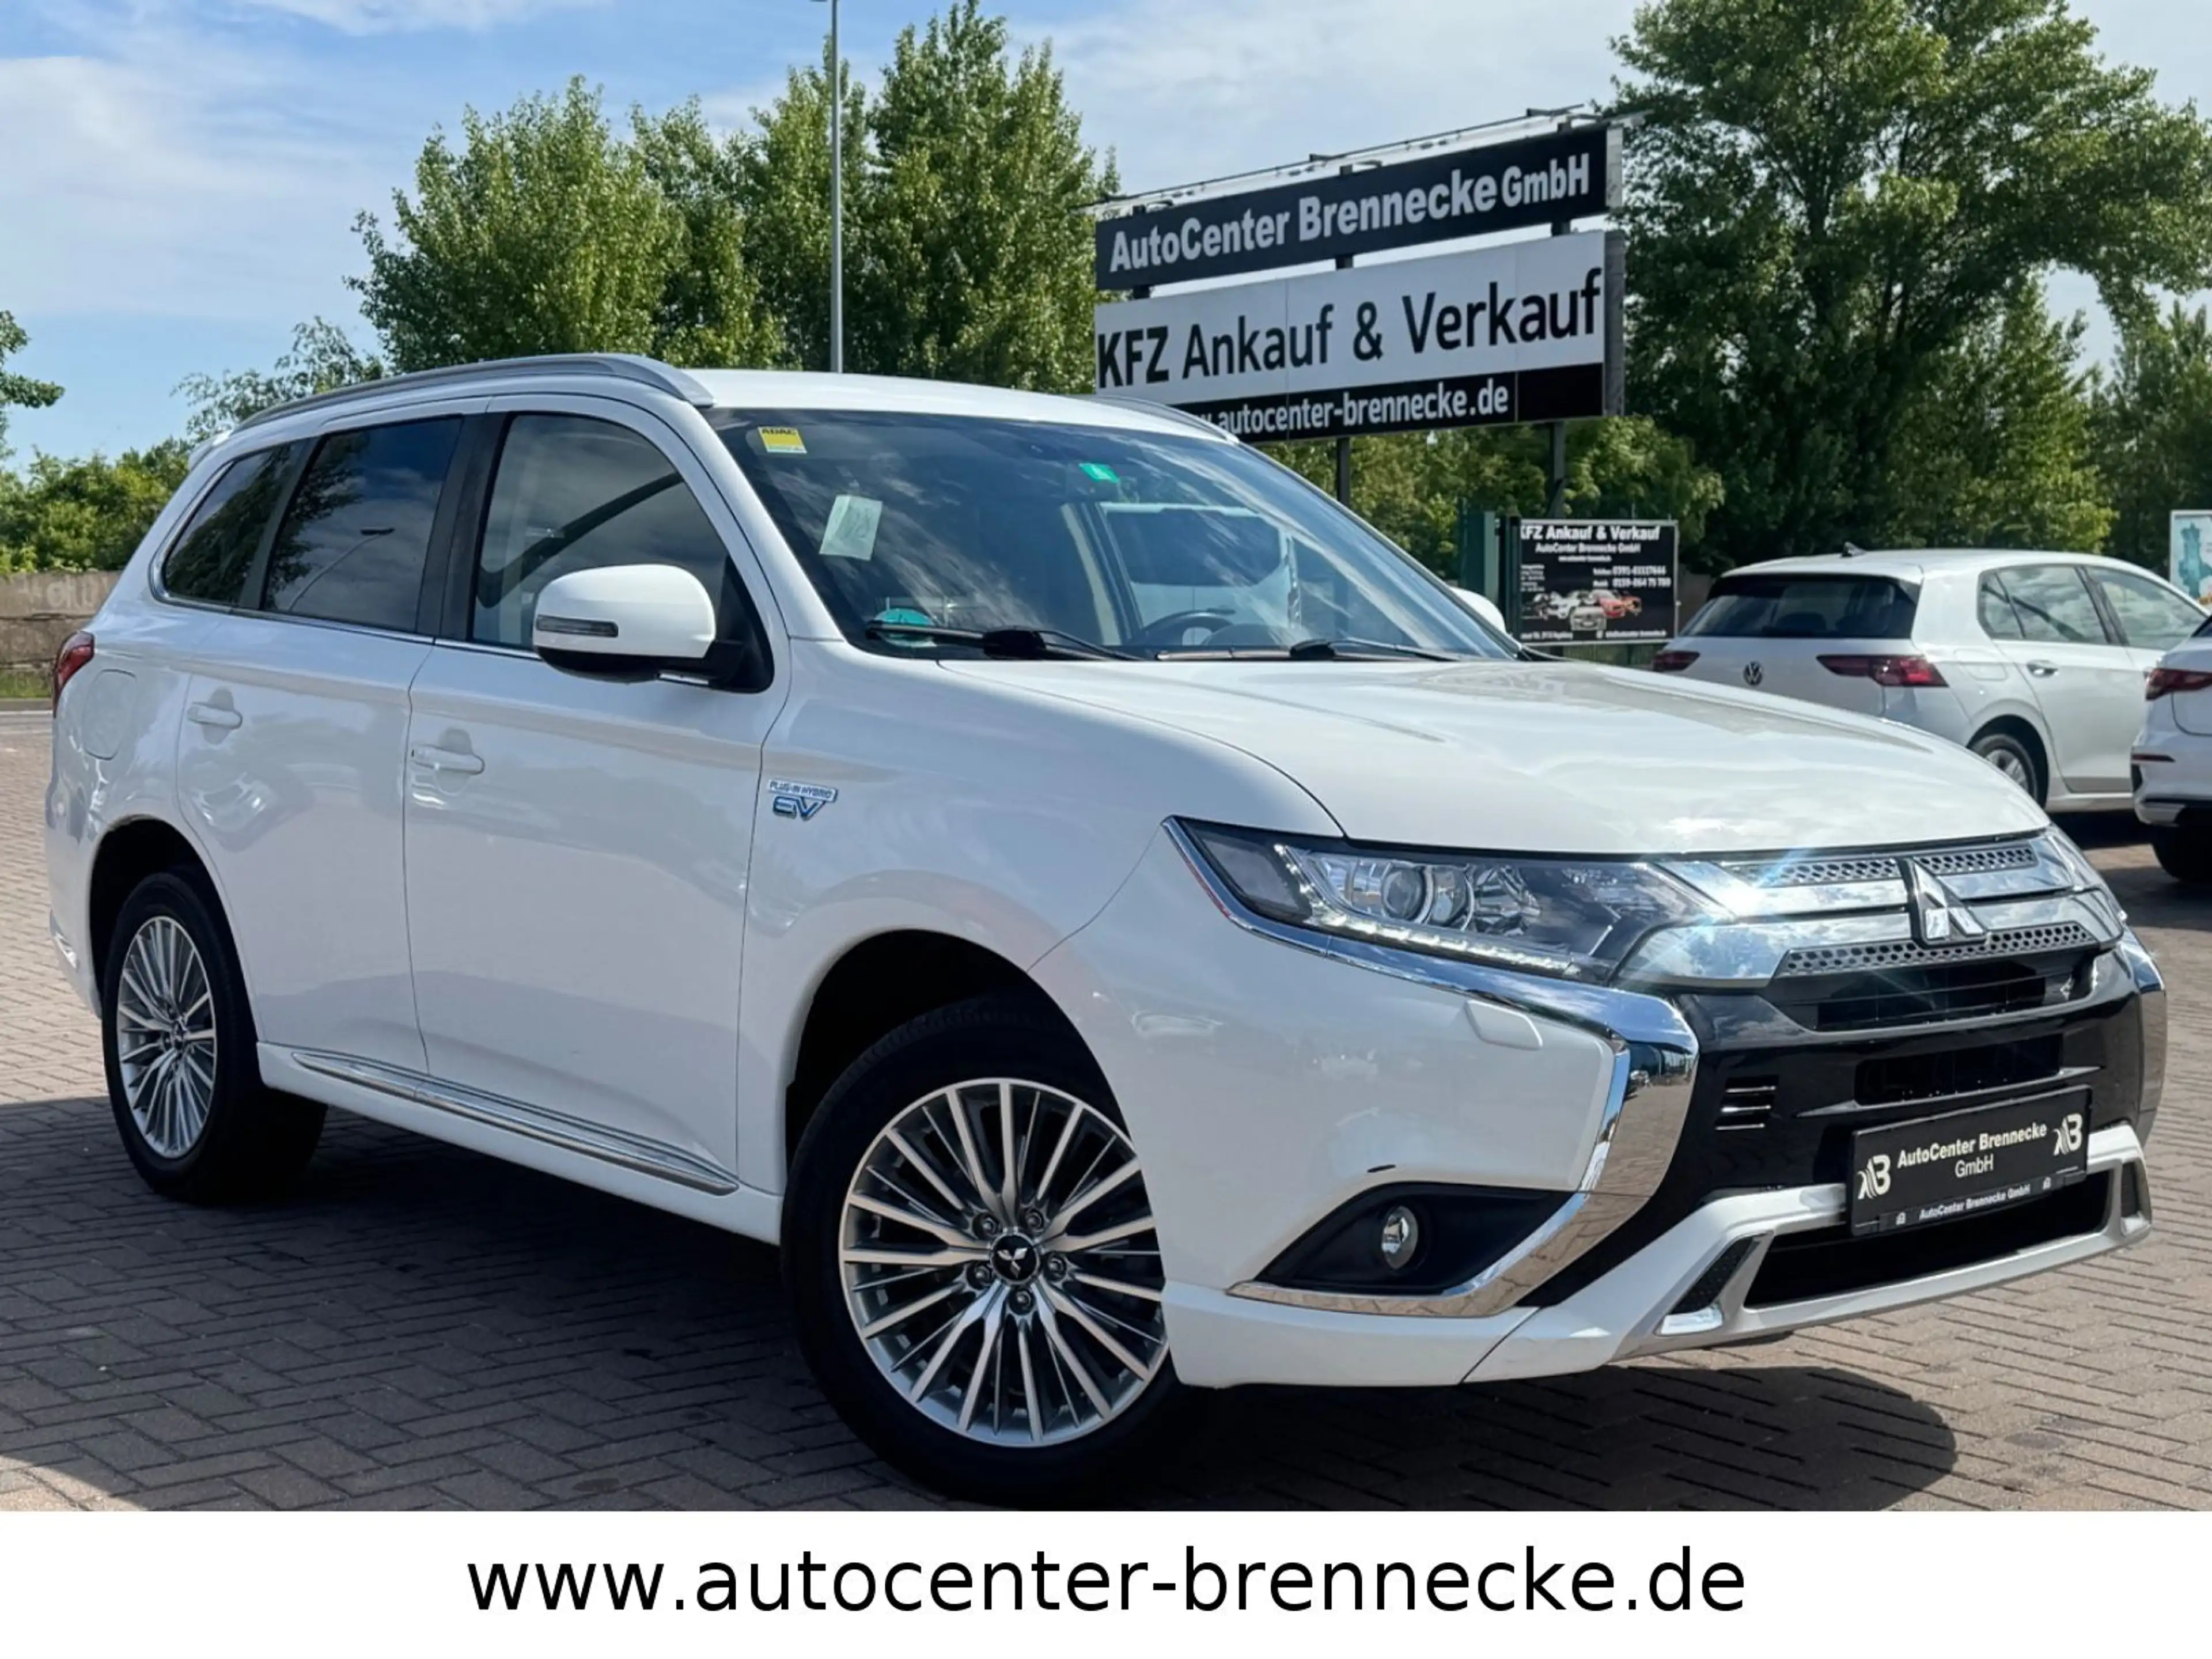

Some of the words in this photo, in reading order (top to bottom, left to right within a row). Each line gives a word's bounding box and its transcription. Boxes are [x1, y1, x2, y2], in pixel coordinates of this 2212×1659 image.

[1109, 209, 1289, 274] AutoCenter
[1299, 169, 1497, 241] Brennecke
[1502, 153, 1590, 206] GmbH
[1098, 326, 1169, 389] KFZ
[1183, 304, 1334, 380] Ankauf
[1354, 302, 1382, 361] &
[1402, 268, 1602, 354] Verkauf
[1546, 525, 1593, 540] Ankauf
[1596, 525, 1607, 540] &
[1610, 525, 1660, 541] Verkauf
[772, 796, 826, 818] EV
[1897, 1137, 1976, 1169] AutoCenter
[1979, 1122, 2047, 1150] Brennecke
[1955, 1154, 1994, 1178] GmbH
[1919, 1202, 1965, 1221] AutoCenter
[1965, 1191, 2006, 1210] Brennecke
[2008, 1183, 2031, 1199] GmbH
